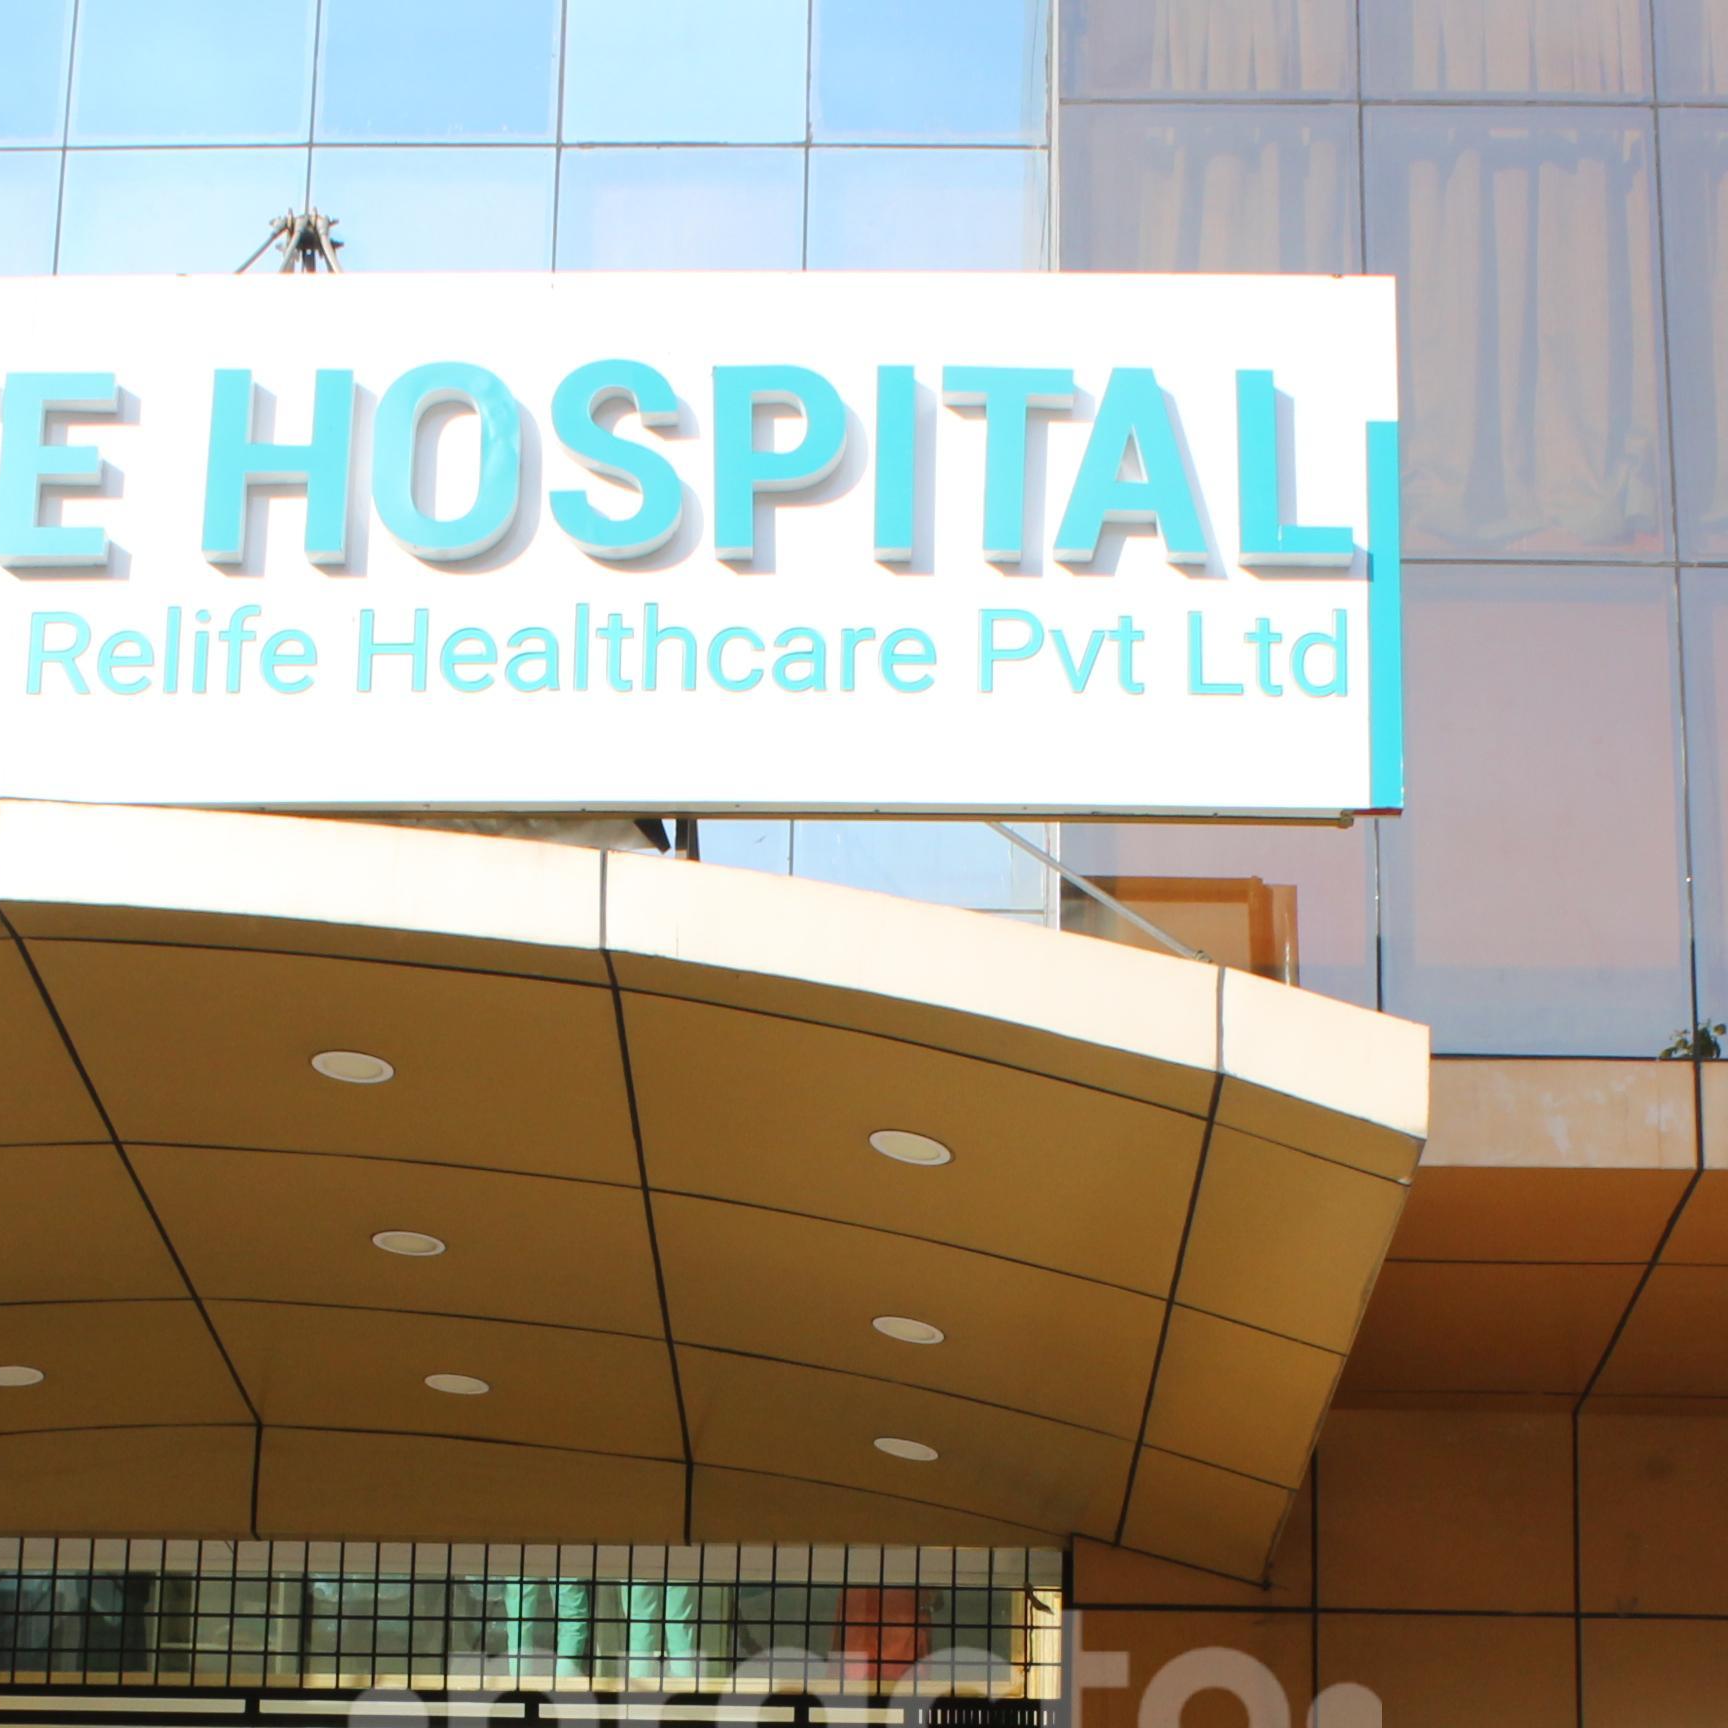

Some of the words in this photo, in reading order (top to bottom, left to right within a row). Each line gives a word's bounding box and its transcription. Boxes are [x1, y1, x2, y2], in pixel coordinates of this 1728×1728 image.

[201, 356, 1358, 568] HOSPITAL
[25, 603, 319, 697] Relife
[355, 601, 938, 695] Healthcare
[978, 606, 1146, 696] Pvt
[1187, 607, 1350, 698] Ltd
